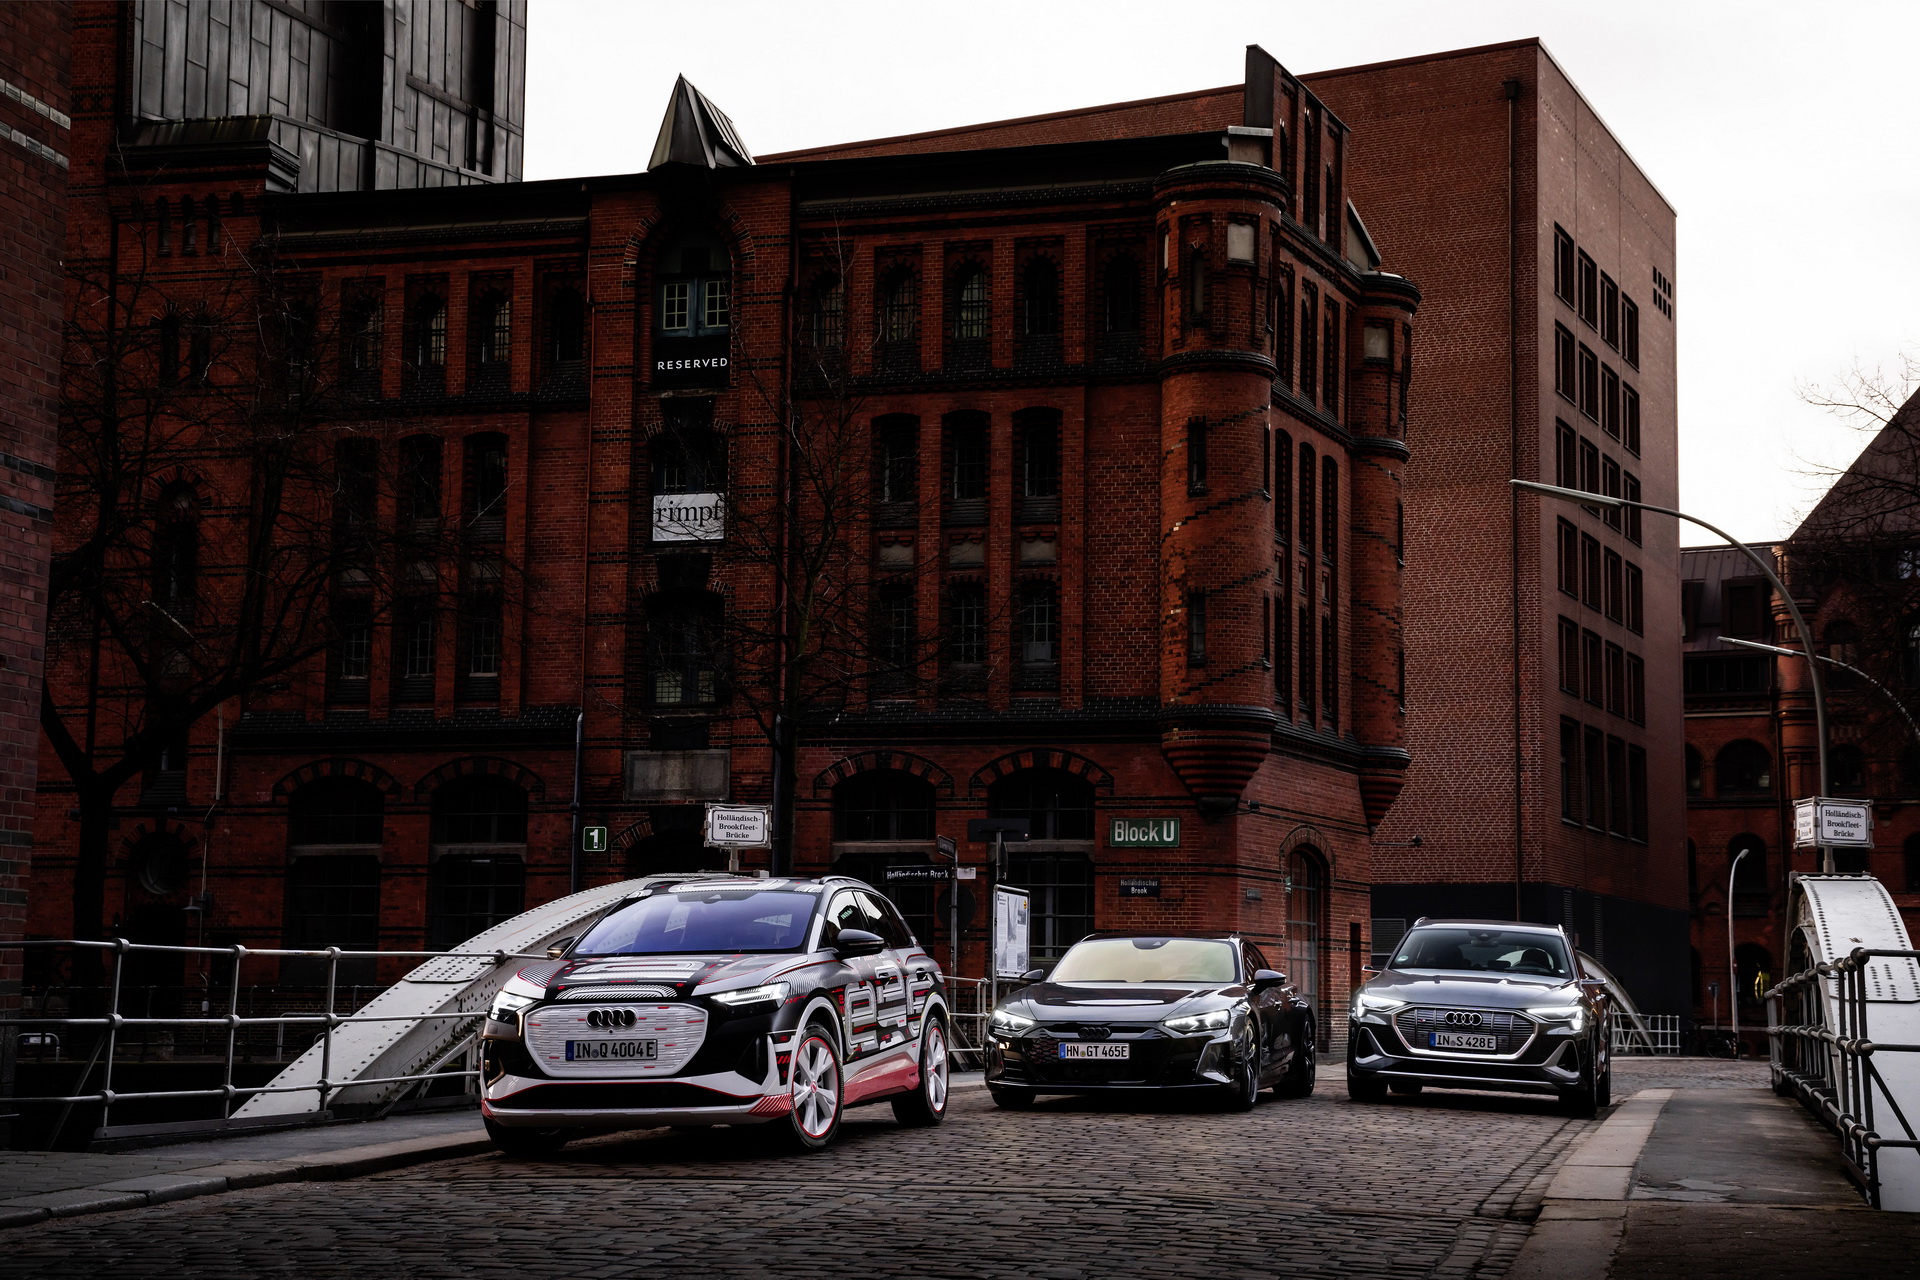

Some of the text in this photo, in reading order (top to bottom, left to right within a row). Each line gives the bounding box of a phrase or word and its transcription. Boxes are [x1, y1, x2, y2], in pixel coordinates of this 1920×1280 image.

[657, 357, 728, 370] RESERVED
[656, 498, 724, 527] rimpf
[717, 814, 761, 822] Holländisch-
[1825, 809, 1864, 819] Holländisch-
[718, 823, 758, 831] Brookfleet-
[1827, 820, 1862, 828] Brookfleet-
[725, 831, 750, 839] Brücke
[1114, 820, 1175, 842] Block U
[1833, 829, 1855, 838] Brücke
[589, 829, 599, 849] 1
[1130, 886, 1148, 894] Brook
[1436, 1034, 1450, 1046] IN
[1456, 1036, 1464, 1047] S
[575, 1042, 591, 1059] IN
[600, 1042, 608, 1058] Q
[1066, 1045, 1128, 1058] HN GT 465E
